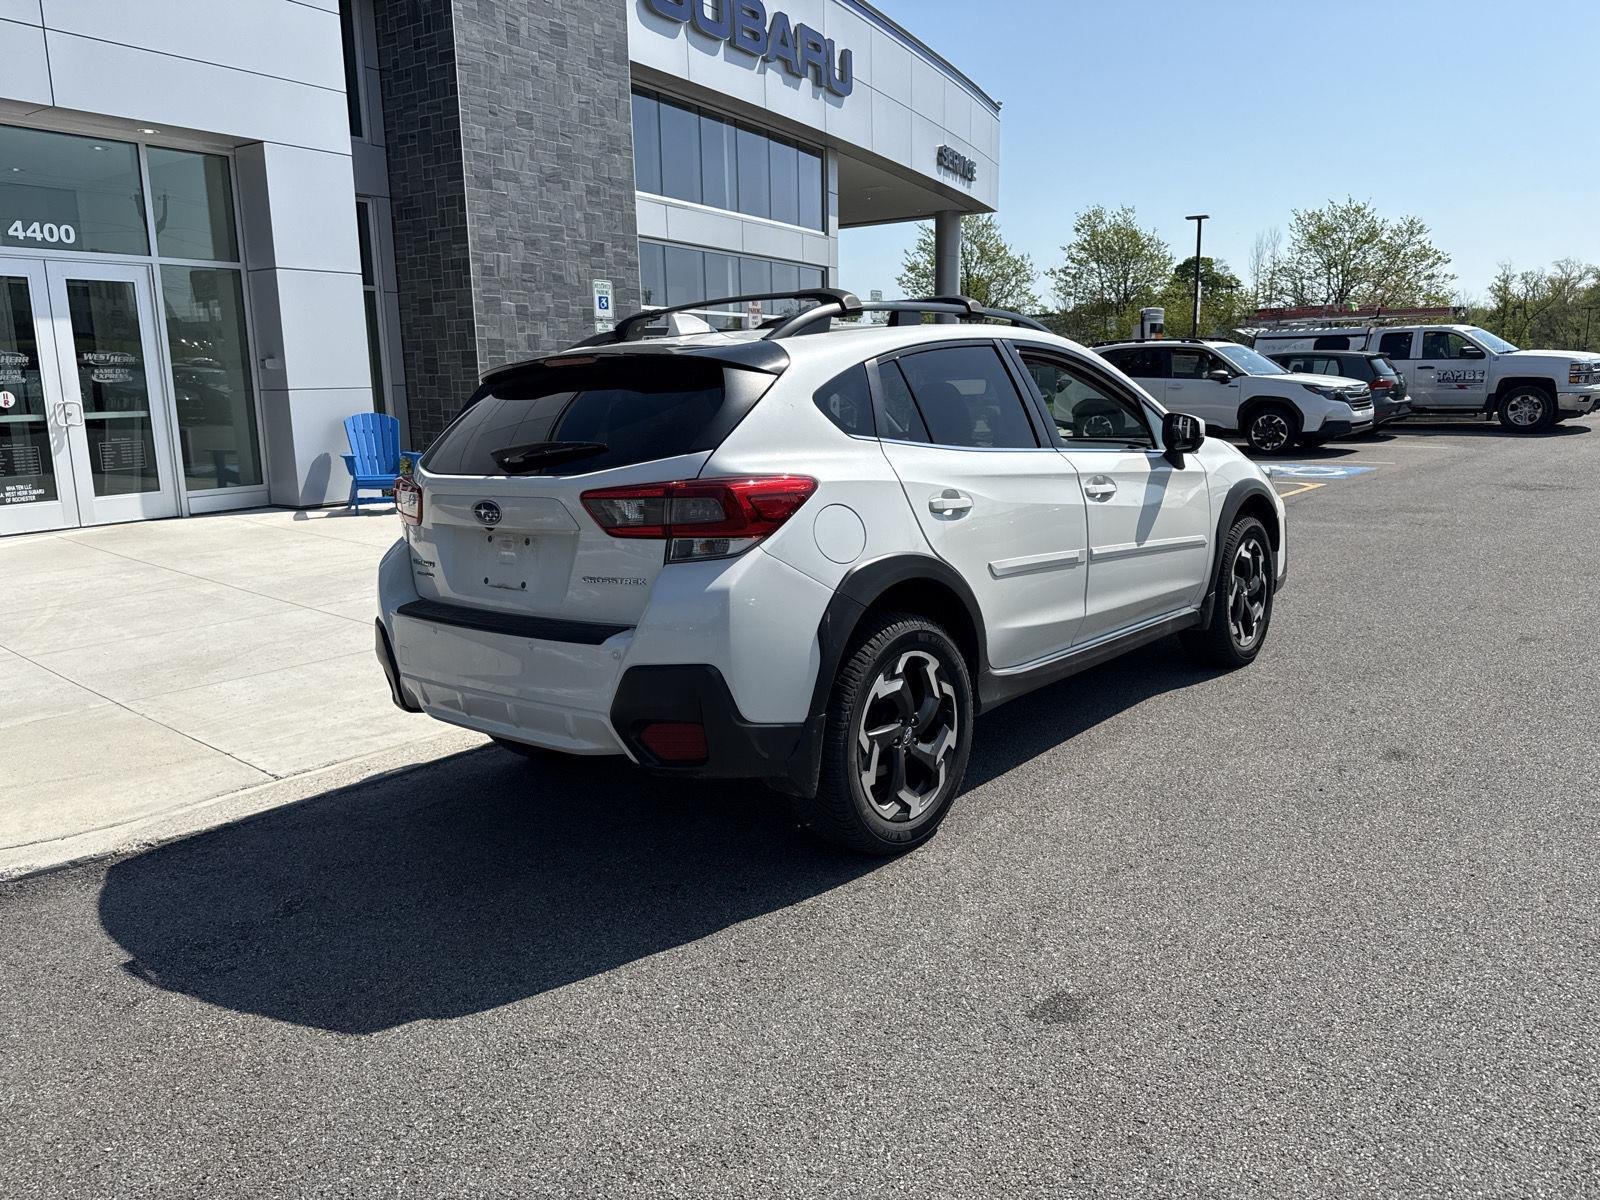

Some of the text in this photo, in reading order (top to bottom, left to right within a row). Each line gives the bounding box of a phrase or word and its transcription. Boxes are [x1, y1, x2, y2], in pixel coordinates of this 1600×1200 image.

[937, 145, 976, 181] SERVICE
[8, 220, 76, 243] 4400
[1437, 369, 1485, 380] TAMBE
[582, 576, 648, 586] CROSSTREK
